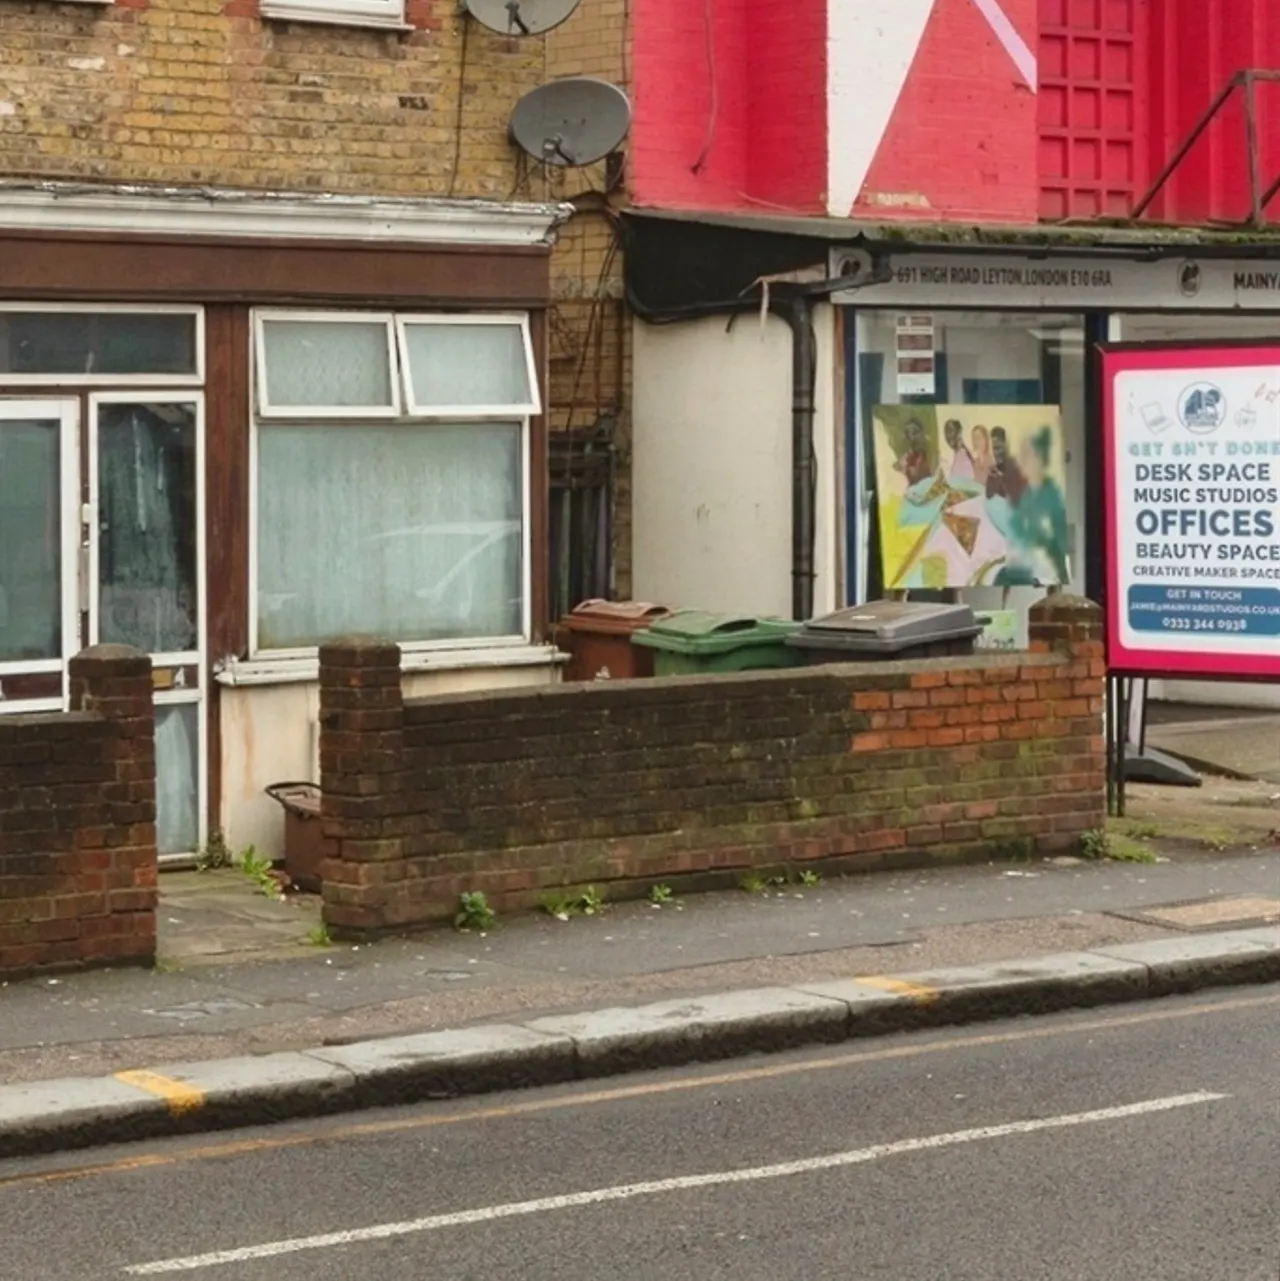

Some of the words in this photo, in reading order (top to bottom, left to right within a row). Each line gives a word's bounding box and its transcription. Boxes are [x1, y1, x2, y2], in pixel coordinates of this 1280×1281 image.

[919, 267, 948, 284] HIGH
[950, 267, 981, 285] ROAD
[1070, 268, 1090, 287] E10
[1091, 269, 1113, 287] 6RA
[1233, 271, 1280, 290] MAINY
[1128, 441, 1164, 457] GET
[1135, 463, 1193, 482] DESK
[1197, 463, 1271, 482] SPACE
[1133, 487, 1191, 504] MUSIC
[1195, 487, 1278, 504] STUDIOS
[1135, 508, 1275, 538] OFFICES
[1136, 542, 1212, 560] BEAUTY
[1216, 543, 1280, 561] SPACE
[1132, 565, 1191, 578] CREATIVE
[1193, 566, 1238, 579] MAKER
[1166, 588, 1188, 600] GET
[1190, 589, 1201, 600] IN
[1203, 590, 1242, 601] TOUCH
